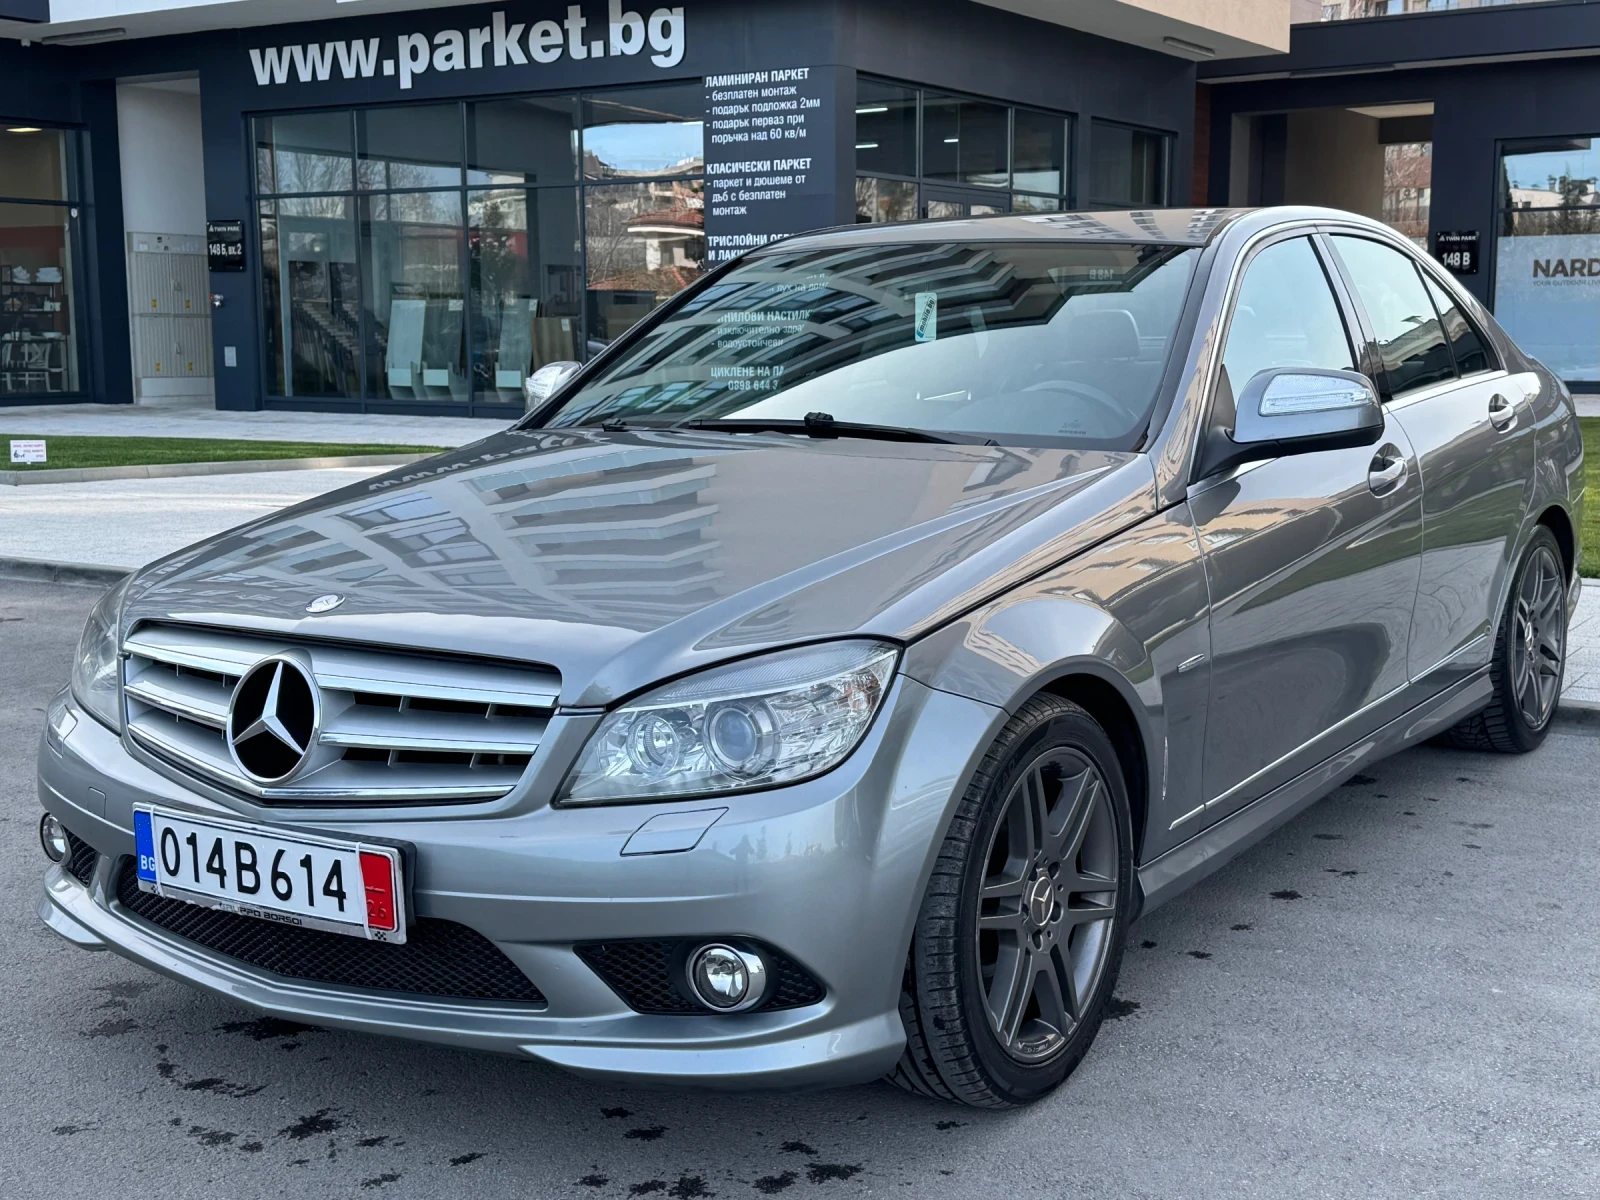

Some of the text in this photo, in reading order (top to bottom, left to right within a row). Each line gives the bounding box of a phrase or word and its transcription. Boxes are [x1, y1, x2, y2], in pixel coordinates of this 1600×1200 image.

[249, 0, 686, 89] www.parket.bg
[705, 68, 809, 87] ЛАМИНИРАН ПАРКЕТ
[712, 86, 797, 101] безплатен монтаж
[712, 97, 820, 116] подарък подложка 2мм
[713, 114, 804, 130] подарък перваз при
[712, 126, 806, 145] поръчка над 60 кв/м
[707, 158, 812, 174] КЛАСИЧЕСКИ ПАРКЕТ
[713, 174, 806, 189] паркет и дюшеме от
[712, 189, 786, 203] дъб с безплатен
[713, 206, 747, 216] монтаж
[708, 233, 767, 246] ТРИСЛОЙНИ
[209, 243, 221, 256] 148
[708, 250, 715, 260] И
[1442, 252, 1460, 266] 148
[767, 310, 813, 321] НАСТИЛК
[783, 324, 804, 334] здра
[711, 367, 754, 378] ЦИКЛЕНЕ
[758, 366, 770, 376] НА
[728, 380, 750, 390] 0898
[754, 380, 770, 390] 644
[141, 827, 347, 912] BG 014B614
[264, 912, 302, 925] BORSOI
